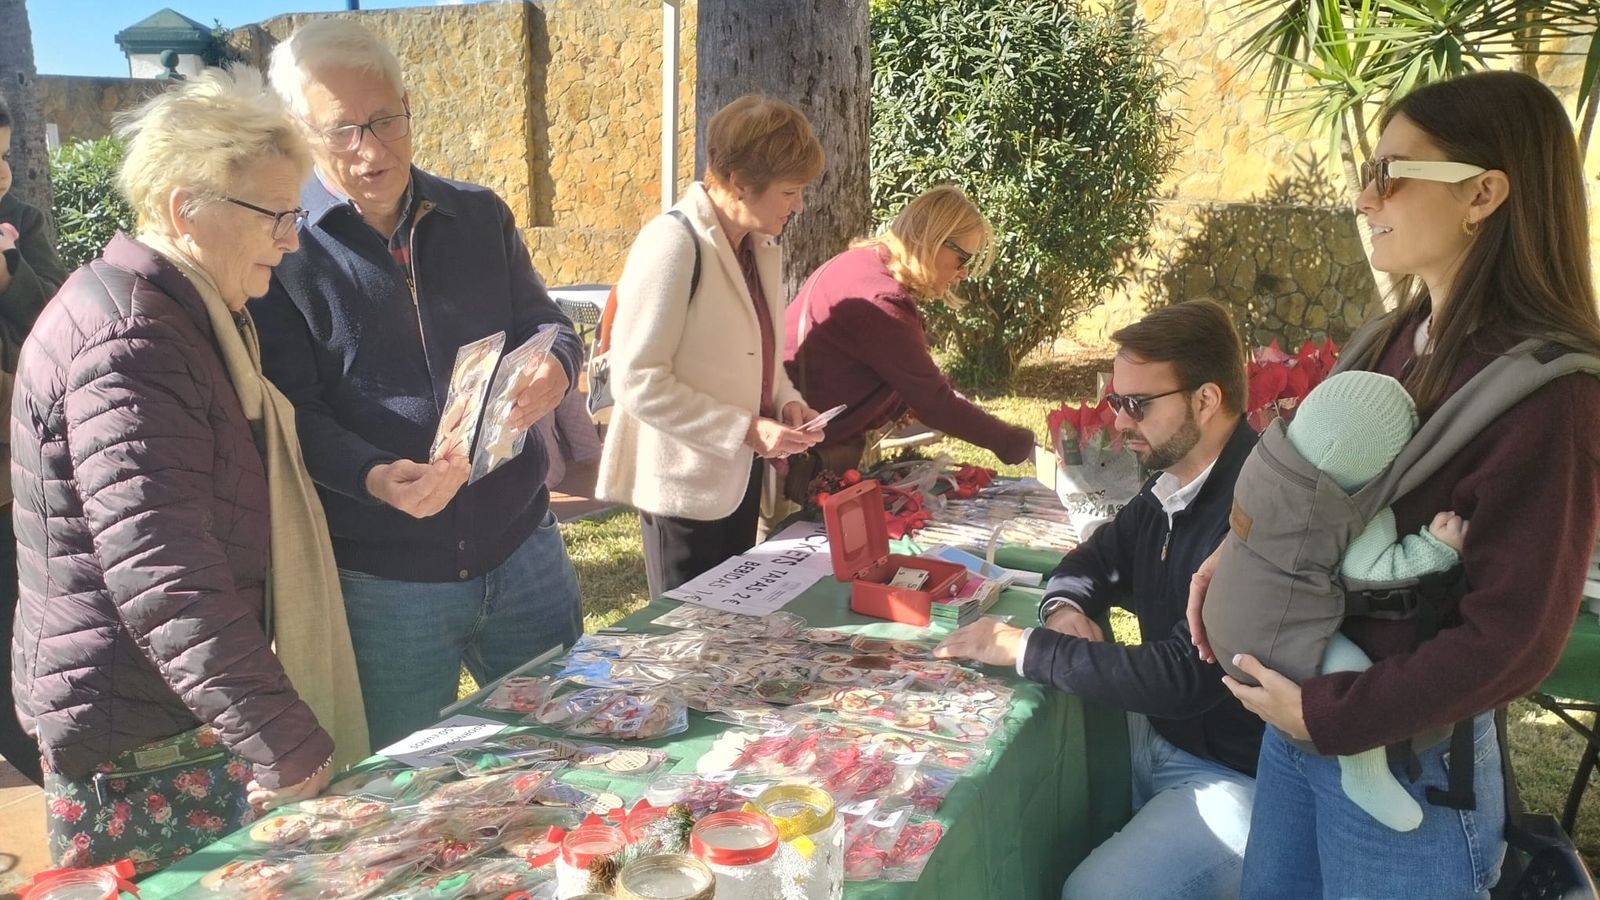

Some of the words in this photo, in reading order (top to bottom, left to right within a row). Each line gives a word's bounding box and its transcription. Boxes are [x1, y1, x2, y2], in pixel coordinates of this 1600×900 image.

[773, 527, 829, 567] ICKETS
[708, 560, 761, 589] BEBIDAS
[745, 569, 789, 592] TAPAS
